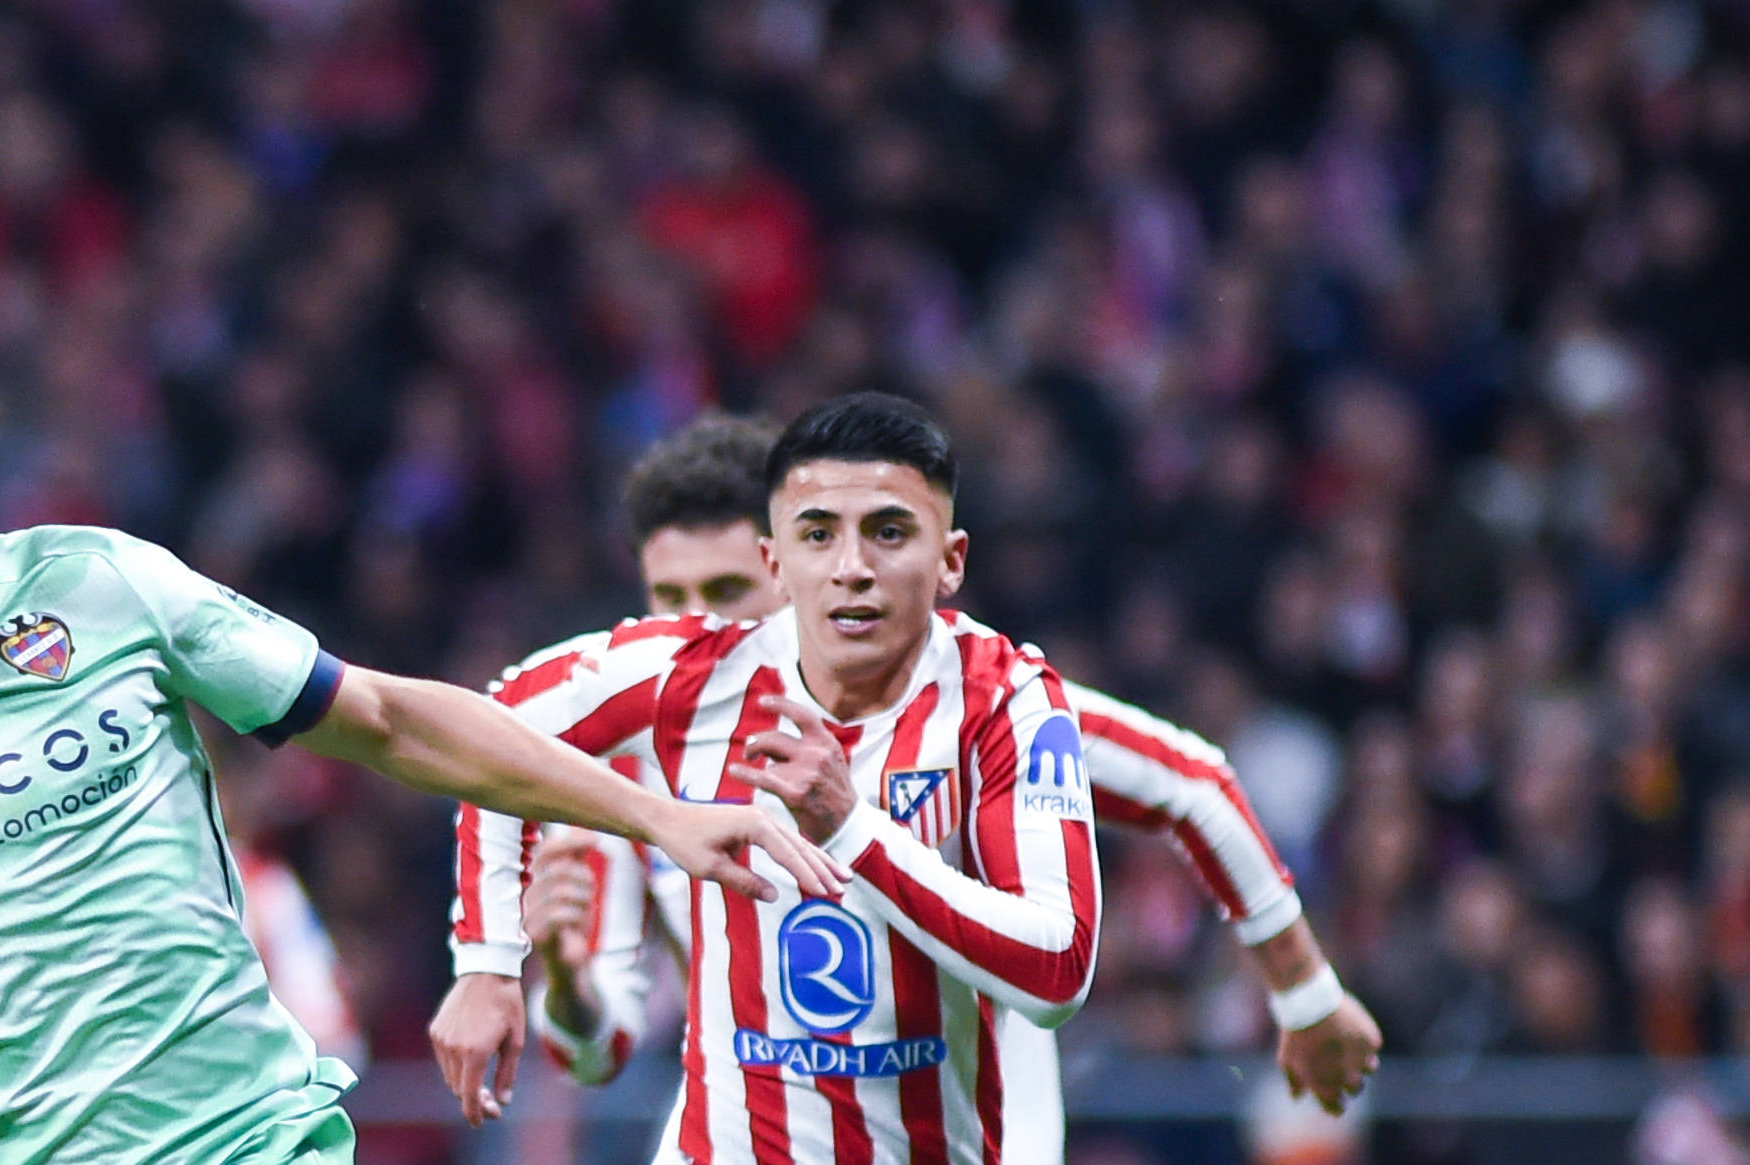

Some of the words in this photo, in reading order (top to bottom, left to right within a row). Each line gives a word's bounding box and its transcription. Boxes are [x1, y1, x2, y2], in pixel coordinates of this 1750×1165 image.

[1024, 793, 1086, 817] krak
[741, 1031, 866, 1075] RIYADH
[878, 1041, 937, 1074] AIR
